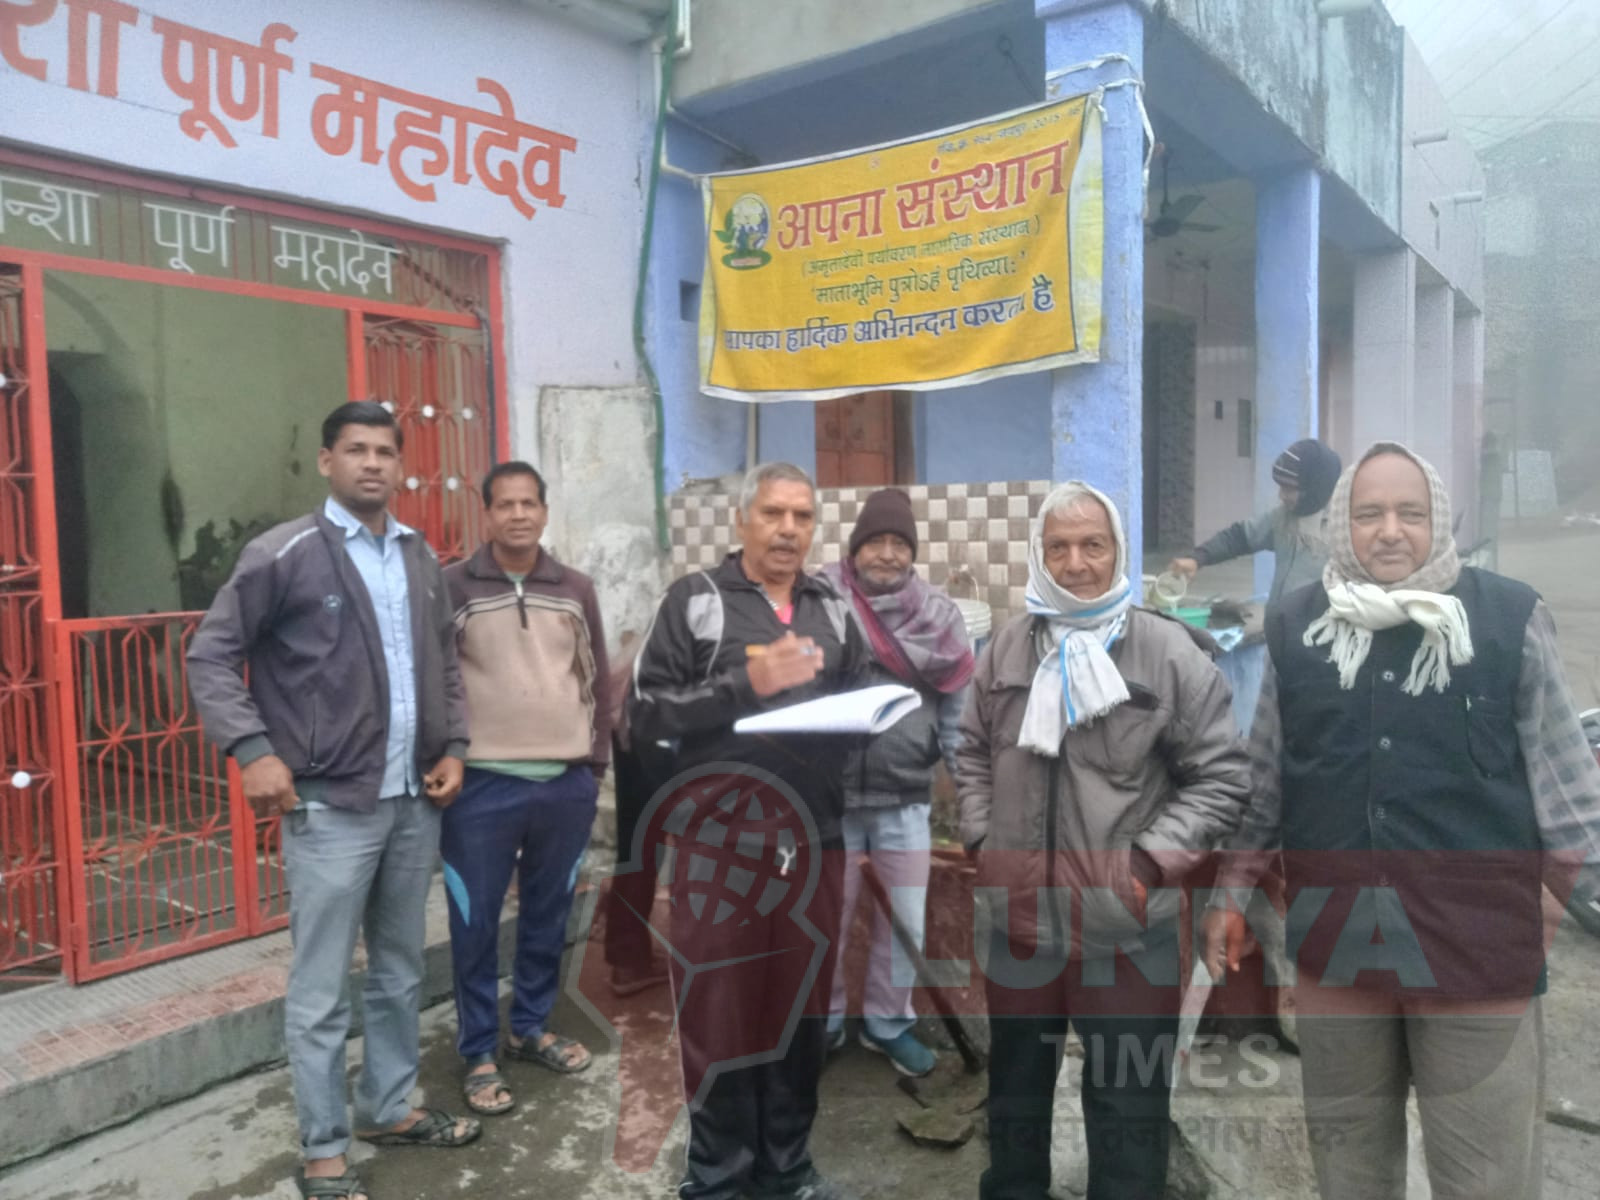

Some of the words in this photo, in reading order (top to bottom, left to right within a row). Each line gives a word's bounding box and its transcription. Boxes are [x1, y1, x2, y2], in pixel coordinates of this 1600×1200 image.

[152, 22, 298, 148] पूर्ण
[310, 62, 577, 220] महादेव
[0, 175, 100, 246] न्शा
[143, 202, 235, 273] पूर्ण
[271, 224, 402, 295] महादेव
[777, 189, 886, 251] अपना
[897, 140, 1071, 229] संस्थान
[785, 316, 848, 352] हार्दिक
[854, 309, 957, 342] अभिनन्दन
[1031, 275, 1054, 311] है
